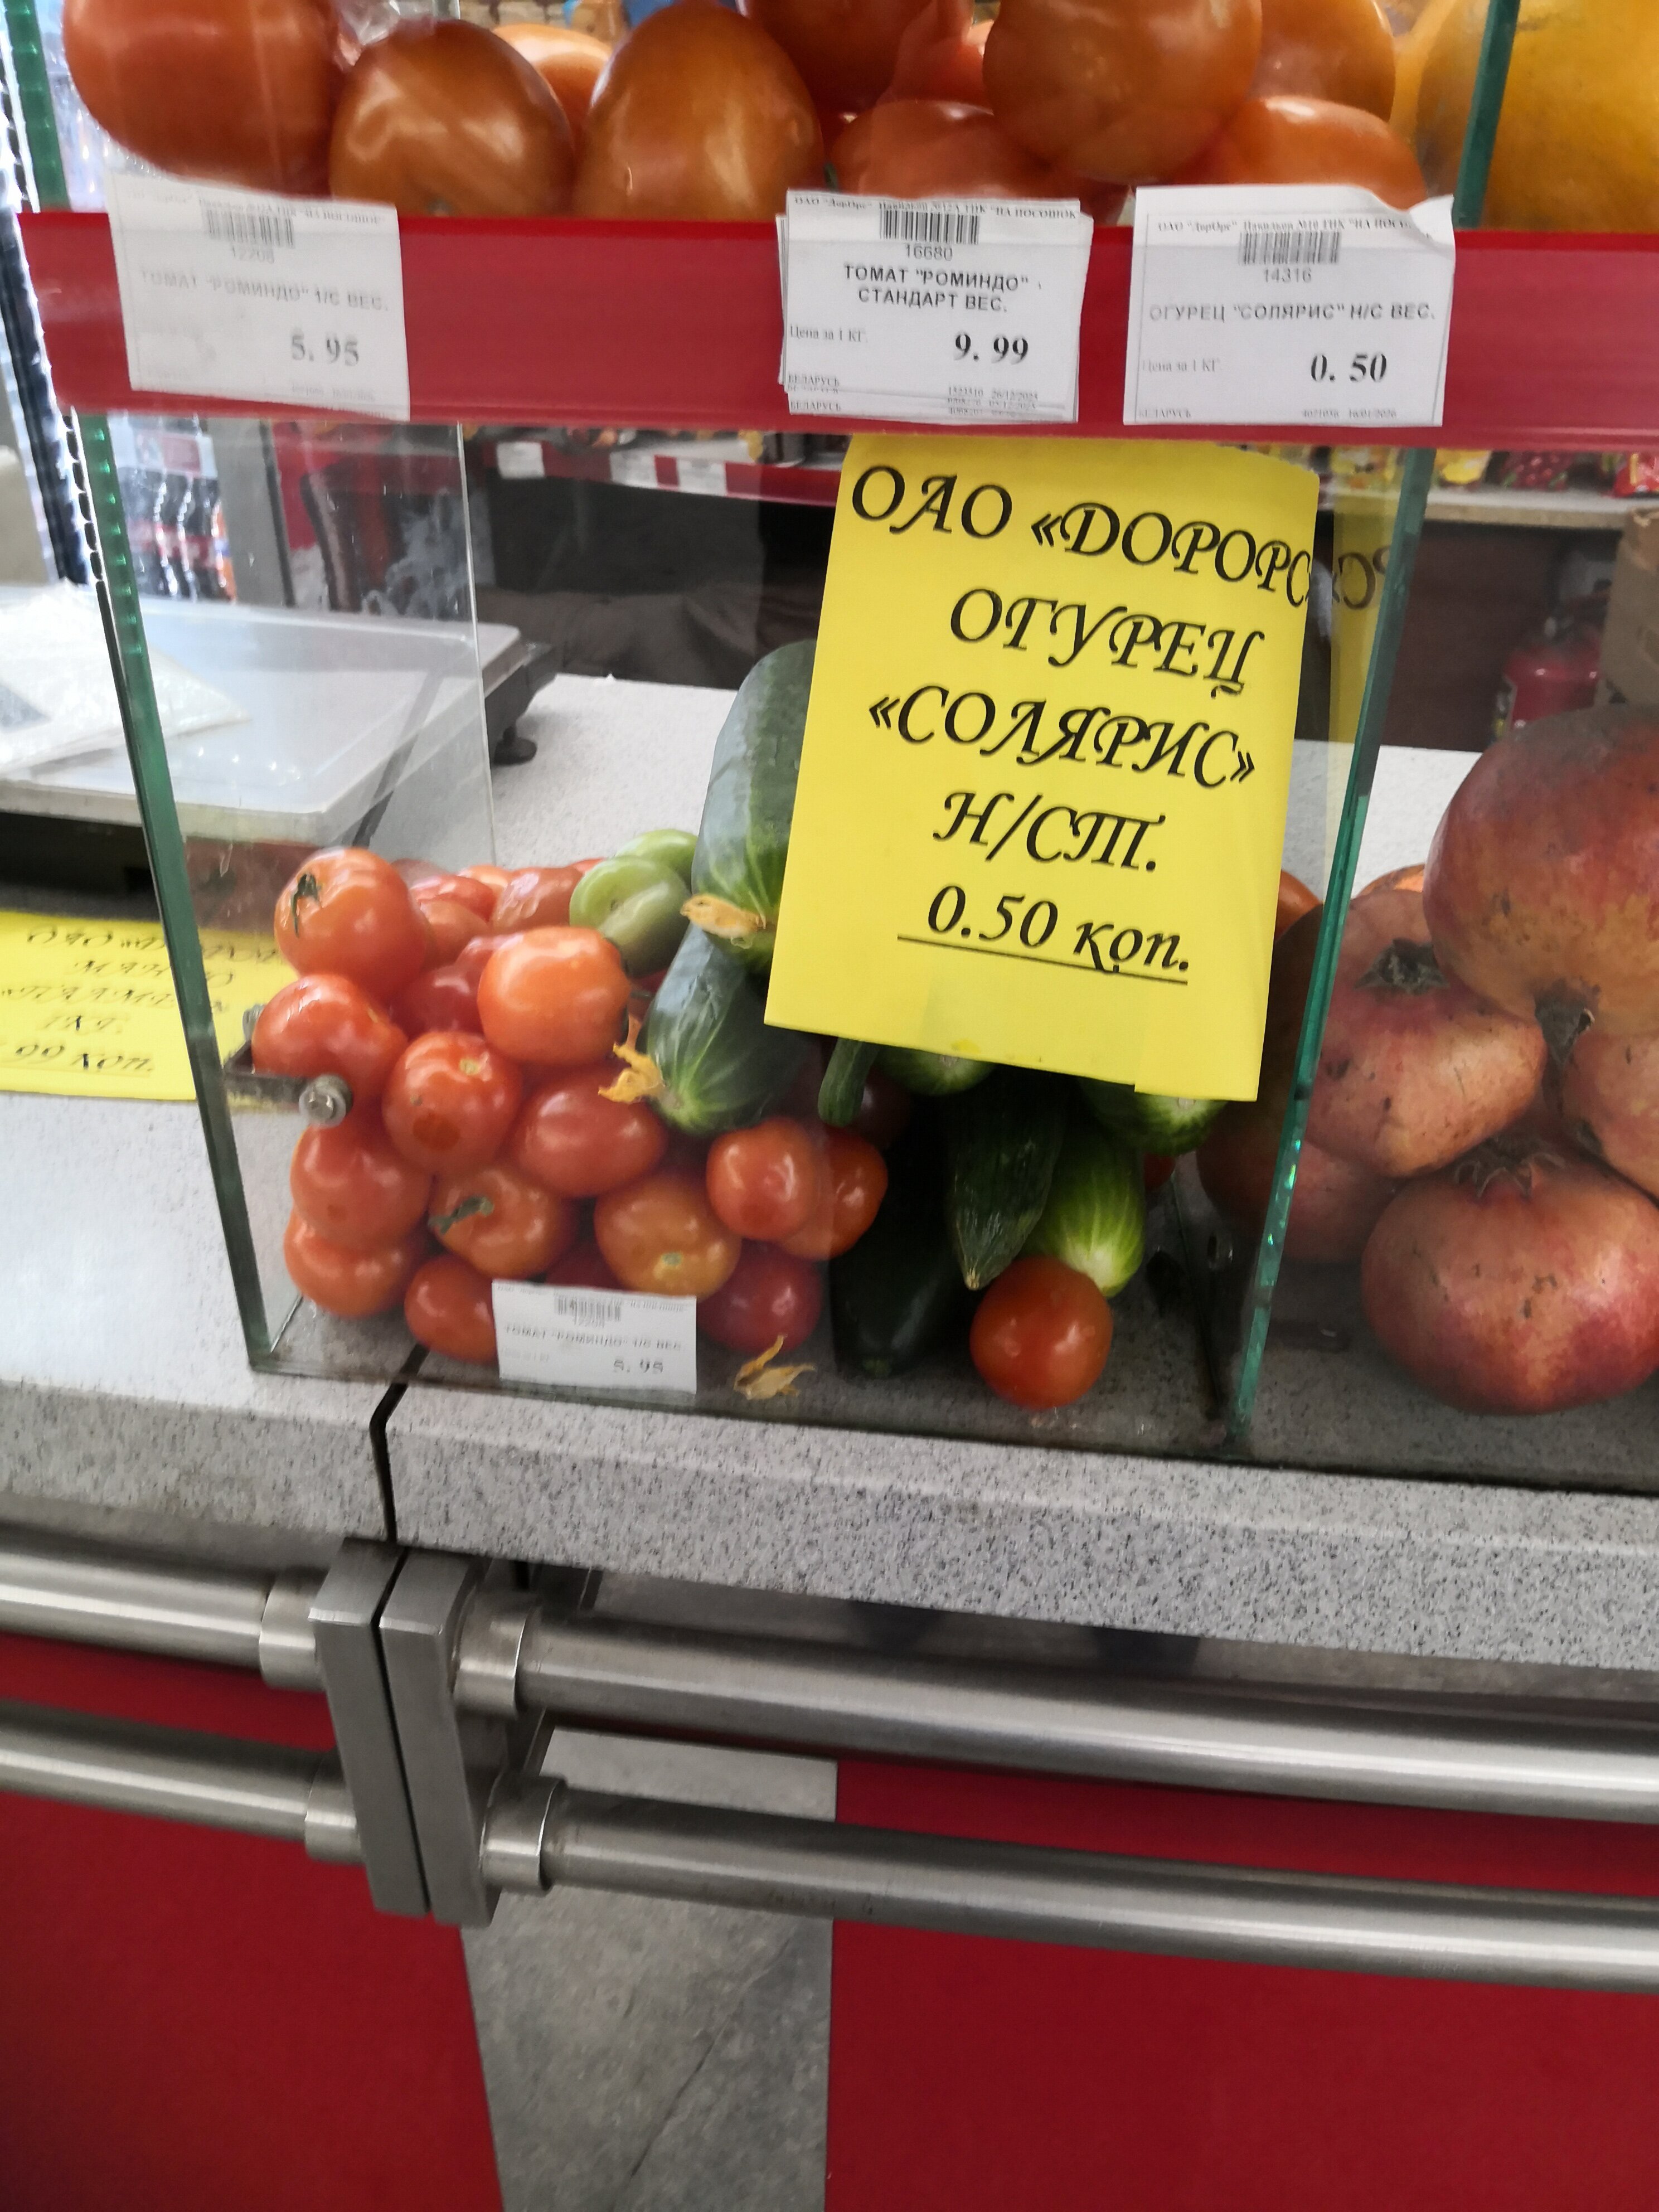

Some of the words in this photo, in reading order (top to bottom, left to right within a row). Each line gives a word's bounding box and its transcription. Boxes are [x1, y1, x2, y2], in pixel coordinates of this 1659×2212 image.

[905, 243, 953, 261] 16680
[843, 264, 909, 284] ТОМАТ
[915, 269, 1029, 293] "РОМИНДО"
[1263, 268, 1312, 283] 14316
[858, 287, 958, 309] СТАНДАРТ
[965, 294, 1008, 313] ВЕС.
[1149, 304, 1226, 323] ОГУРЕЦ
[1234, 303, 1345, 321] "СОЛЯРИС"
[1350, 304, 1384, 320] Н/С
[1390, 304, 1435, 321] ВЕС.
[789, 324, 819, 341] Цена
[290, 330, 360, 367] 5.95
[953, 333, 1029, 365] 9.99
[1310, 352, 1388, 383] 0.50
[852, 464, 1013, 540] ОАО
[1030, 502, 1312, 609] «ДОРОРС
[949, 588, 1265, 700] ОГУРЕЦ
[869, 684, 1255, 789] «СОЛЯРИС»
[933, 791, 1167, 871] Н/СТ.
[926, 884, 1059, 949] 0.50
[1073, 918, 1190, 974] коп.
